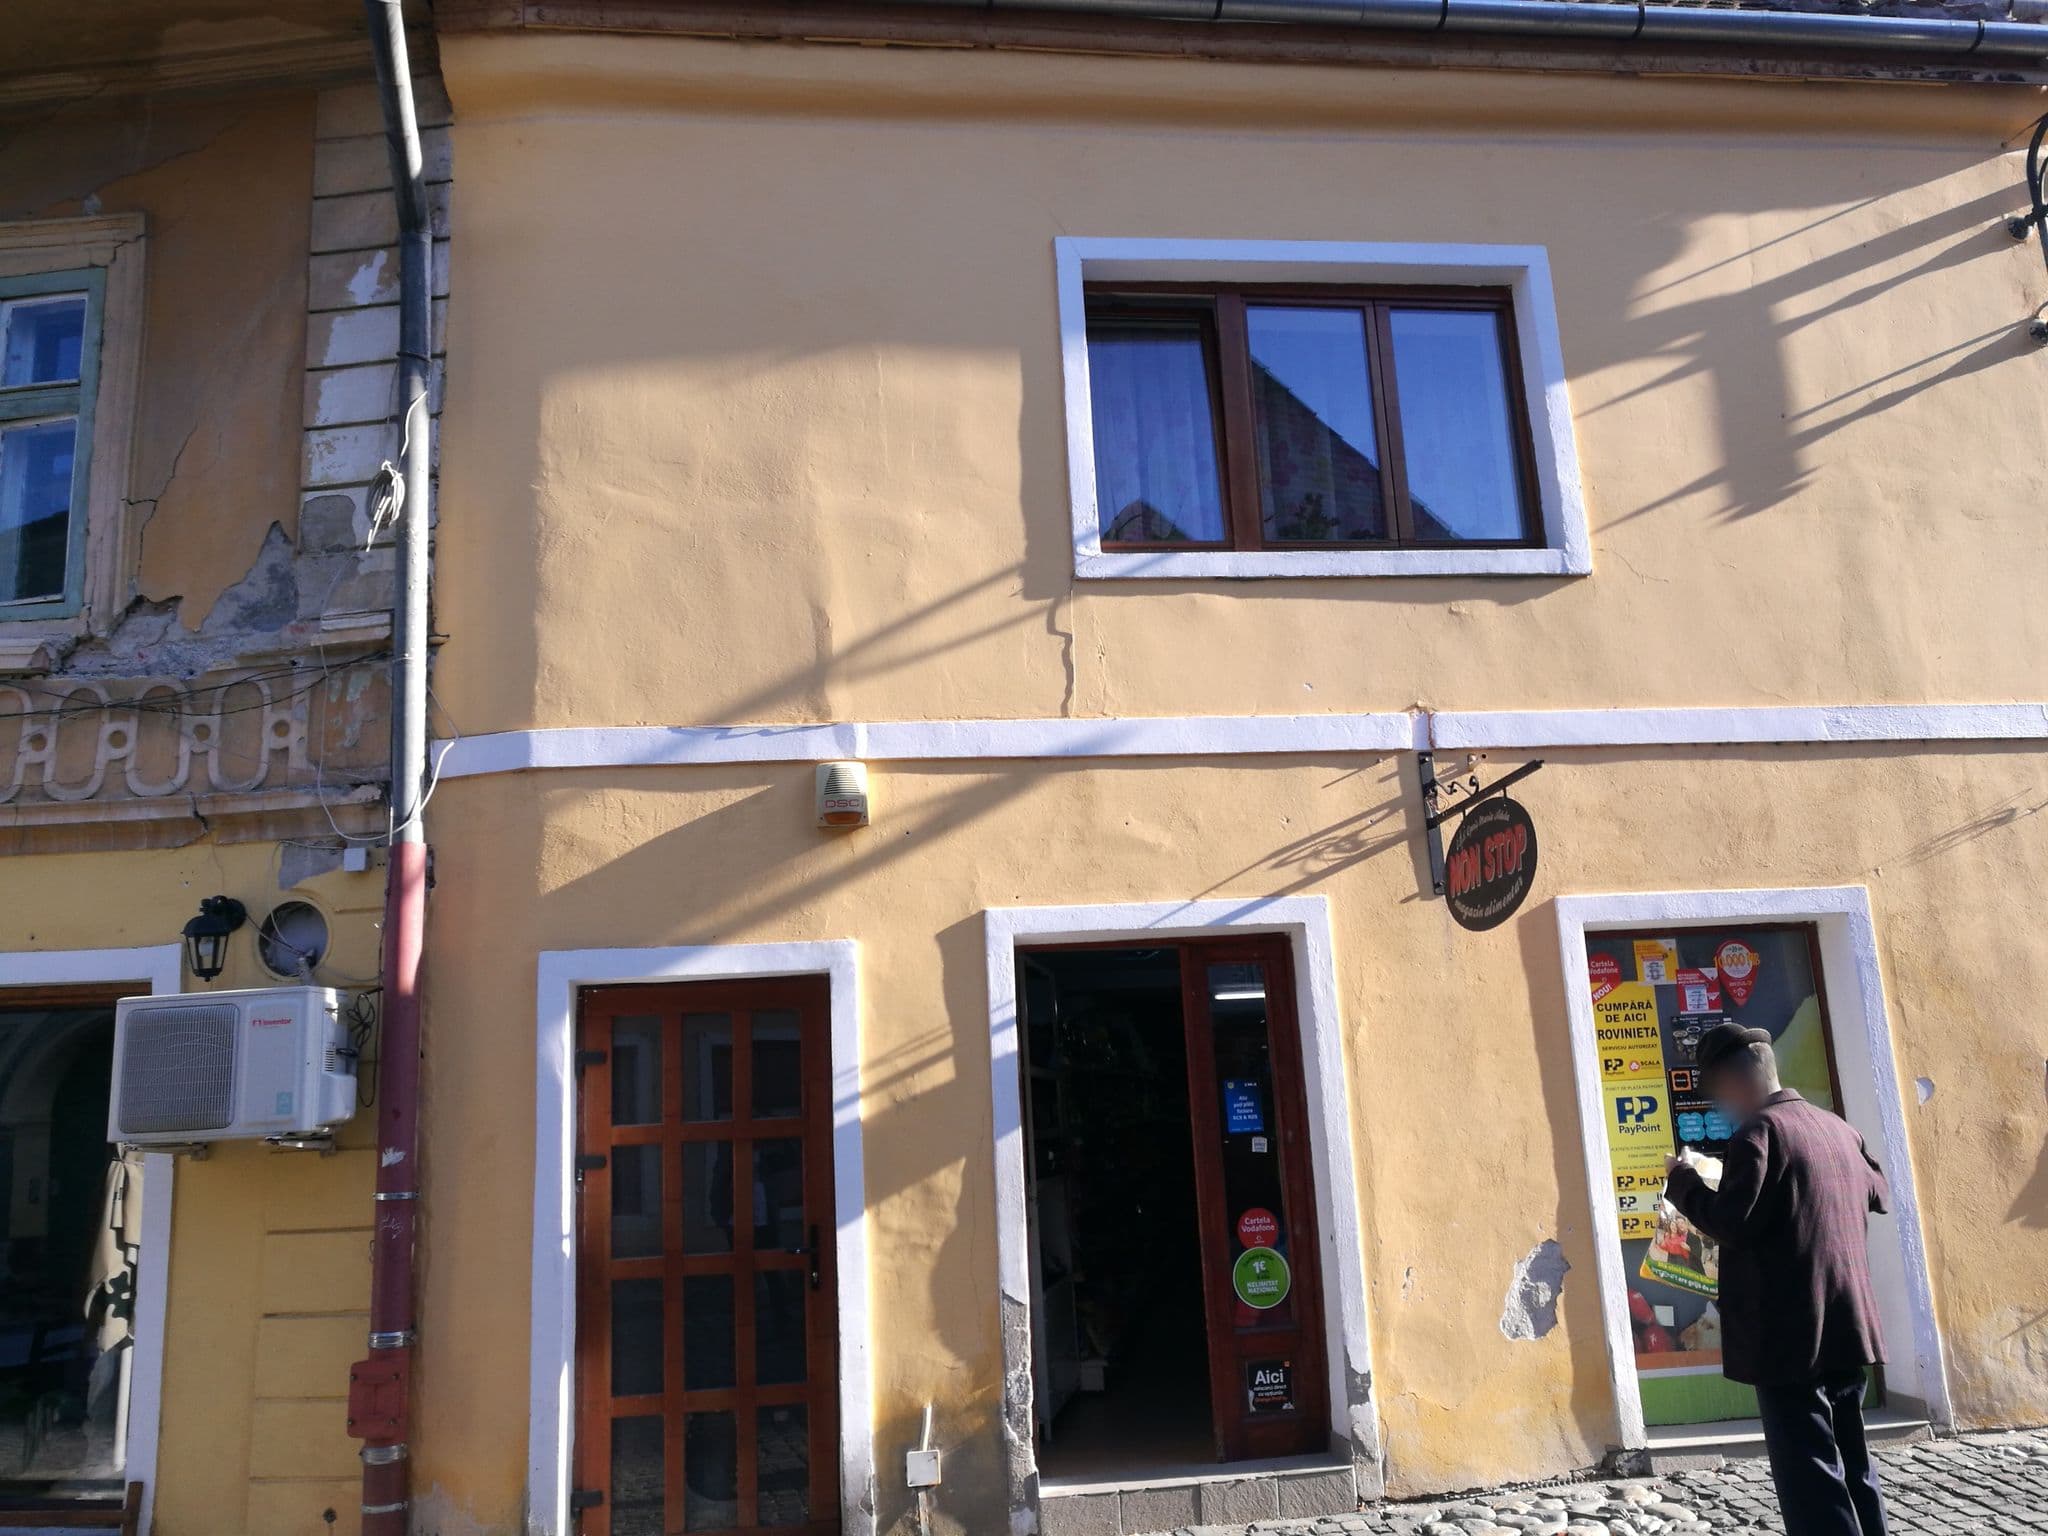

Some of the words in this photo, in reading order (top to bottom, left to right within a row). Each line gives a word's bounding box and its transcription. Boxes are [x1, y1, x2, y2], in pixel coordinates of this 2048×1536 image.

[1449, 842, 1481, 898] NON
[1484, 822, 1527, 883] STOP
[1605, 1014, 1620, 1023] DE
[1624, 1012, 1647, 1022] AICI
[1598, 1026, 1658, 1040] ROVINIETA
[1618, 1124, 1662, 1136] PayPoint
[1639, 1175, 1667, 1186] PLĂT
[1244, 1217, 1271, 1225] Cartela
[1241, 1224, 1275, 1232] Vodafone
[1255, 1368, 1284, 1385] Aici
